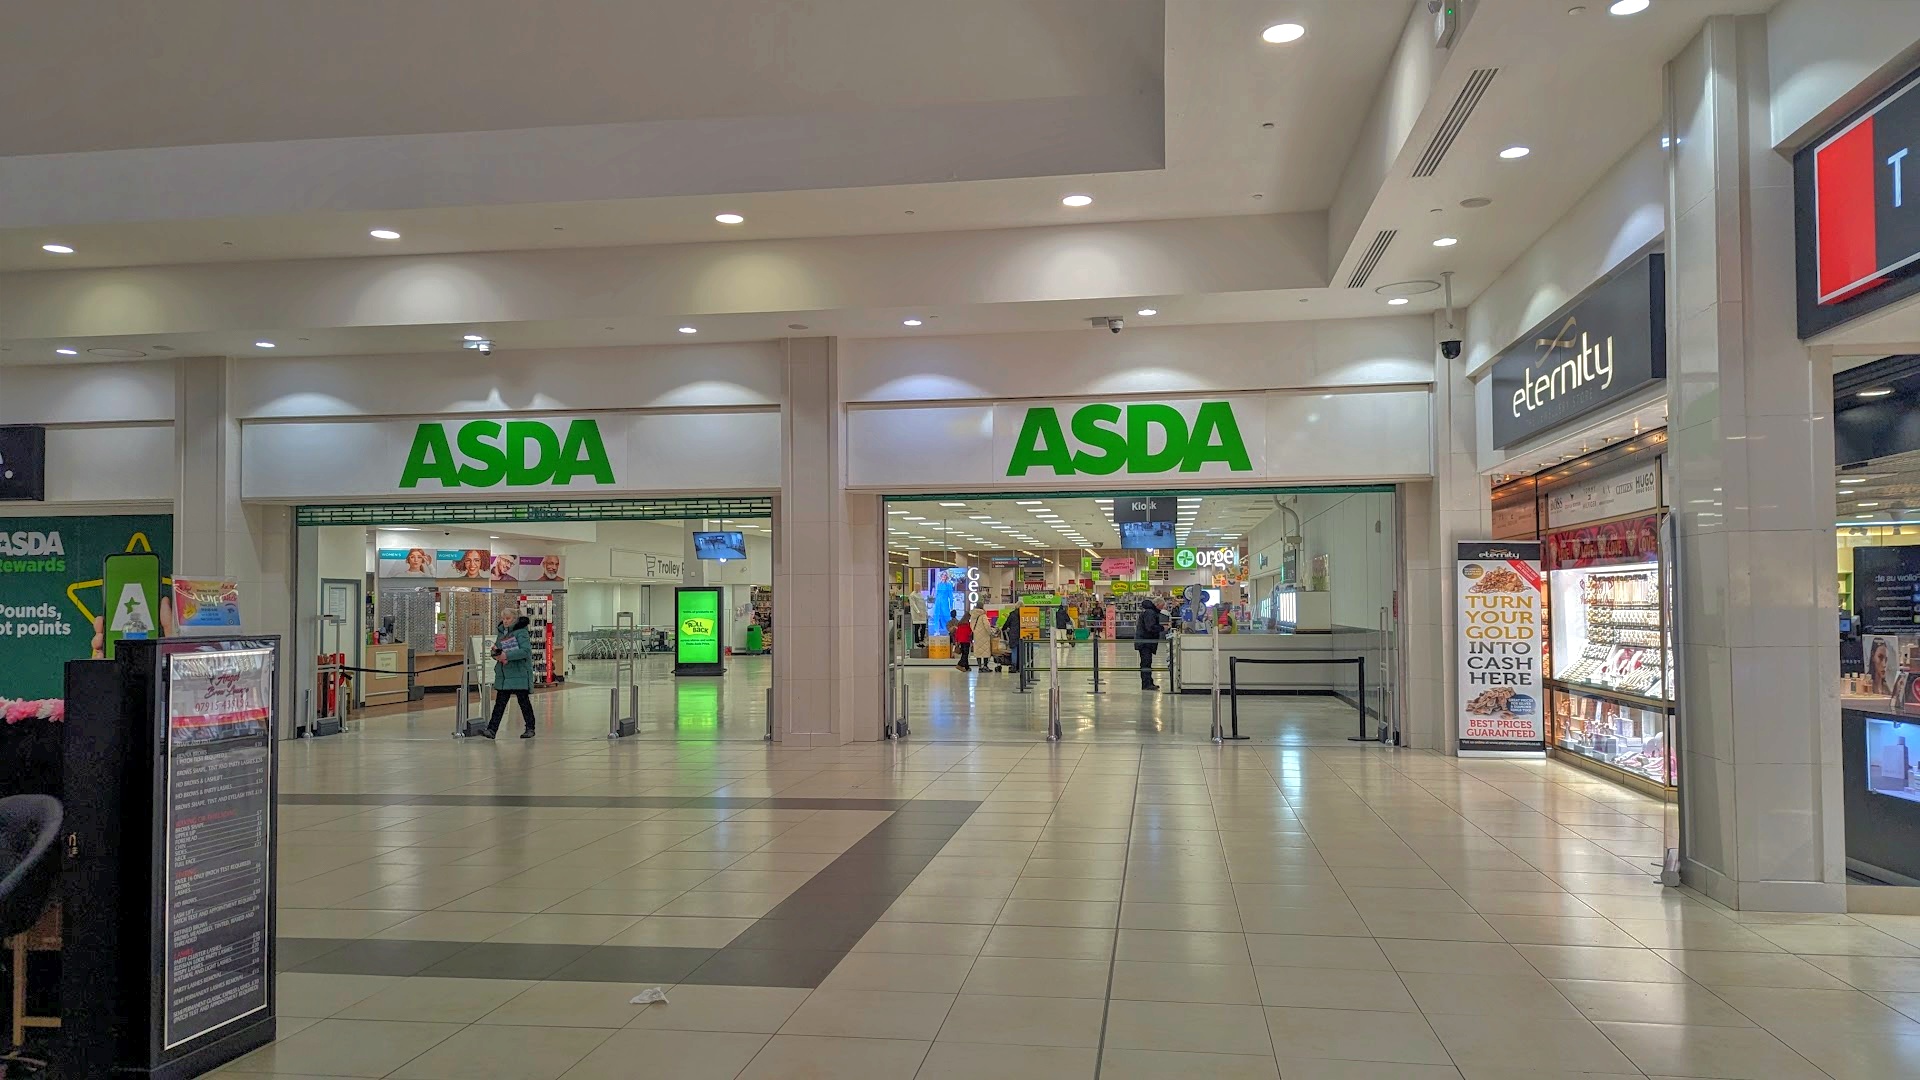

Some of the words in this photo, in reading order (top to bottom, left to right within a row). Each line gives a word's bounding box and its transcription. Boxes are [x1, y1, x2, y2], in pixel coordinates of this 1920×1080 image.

[1513, 332, 1613, 417] eternity
[1006, 402, 1253, 476] ASDA
[399, 420, 615, 488] ASDA
[1635, 472, 1654, 489] HUGO
[1615, 482, 1634, 495] CITIZEN
[0, 531, 65, 556] ASDA
[1195, 547, 1234, 570] orge
[1478, 550, 1520, 560] eternity
[0, 559, 65, 572] ewards
[658, 560, 680, 577] Trolley
[1465, 595, 1534, 609] TURN
[1465, 611, 1534, 624] YOUR
[17, 623, 71, 638] points
[1465, 626, 1534, 639] GOLD
[1469, 641, 1531, 654] INTO
[1467, 657, 1533, 670] CASH
[216, 671, 242, 688] Angel
[1469, 672, 1532, 685] HERE
[205, 685, 224, 698] Brow
[195, 701, 219, 712] 07915
[1470, 719, 1496, 728] BEST
[1497, 720, 1532, 729] PRICES
[1466, 728, 1535, 738] GUARANTEED
